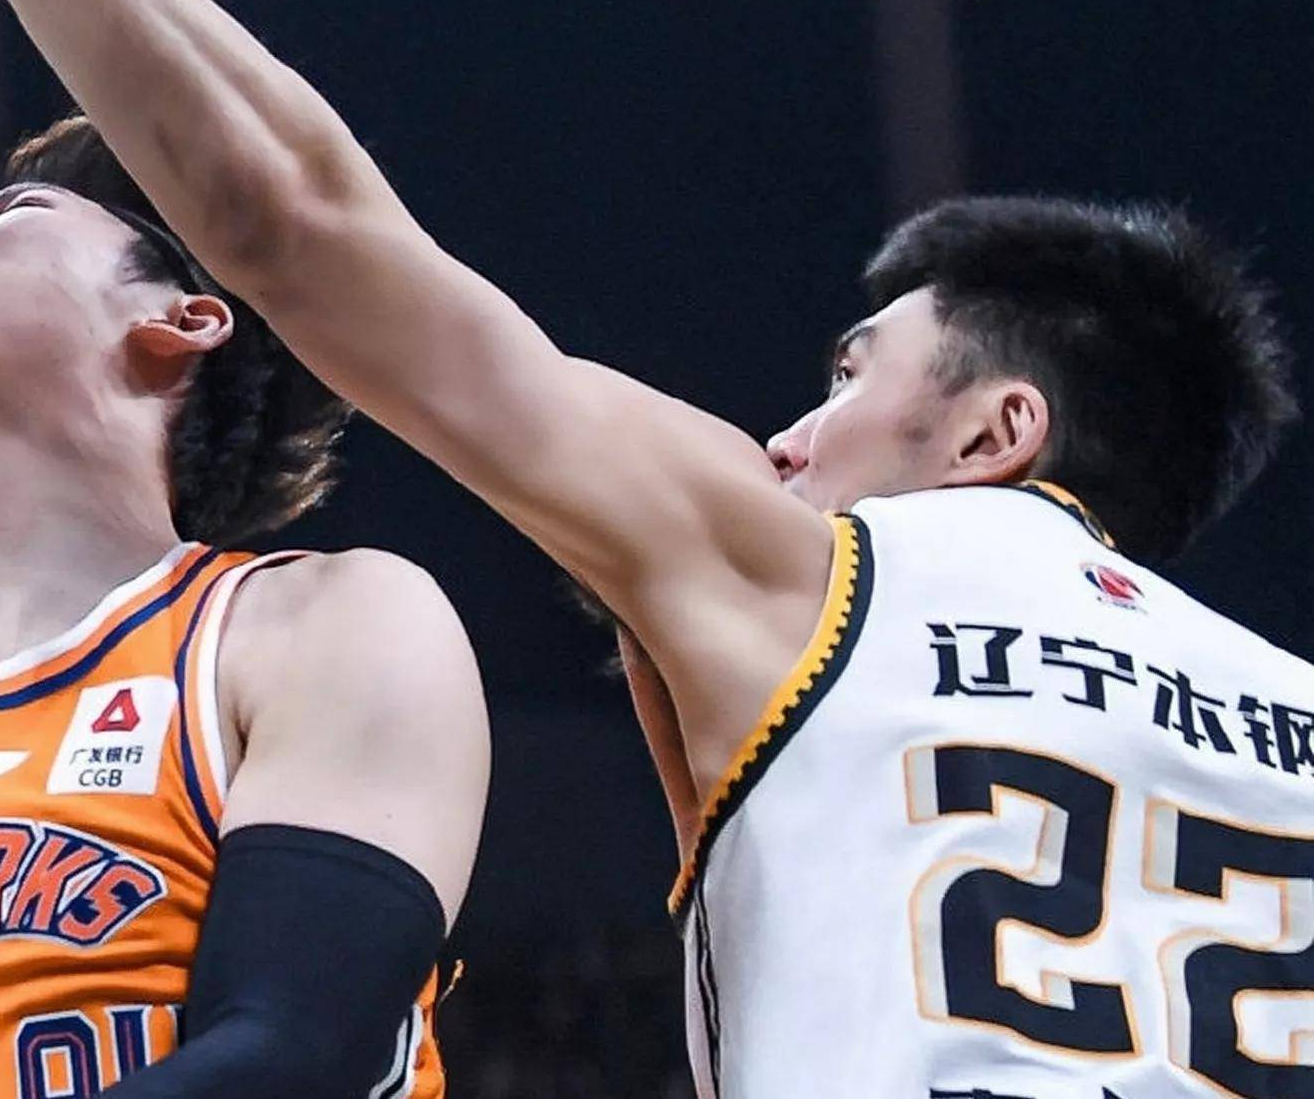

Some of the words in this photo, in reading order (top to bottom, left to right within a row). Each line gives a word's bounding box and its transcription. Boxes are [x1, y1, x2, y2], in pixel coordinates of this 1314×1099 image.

[926, 622, 1314, 776] 辽宁本钢
[78, 768, 123, 788] CGB
